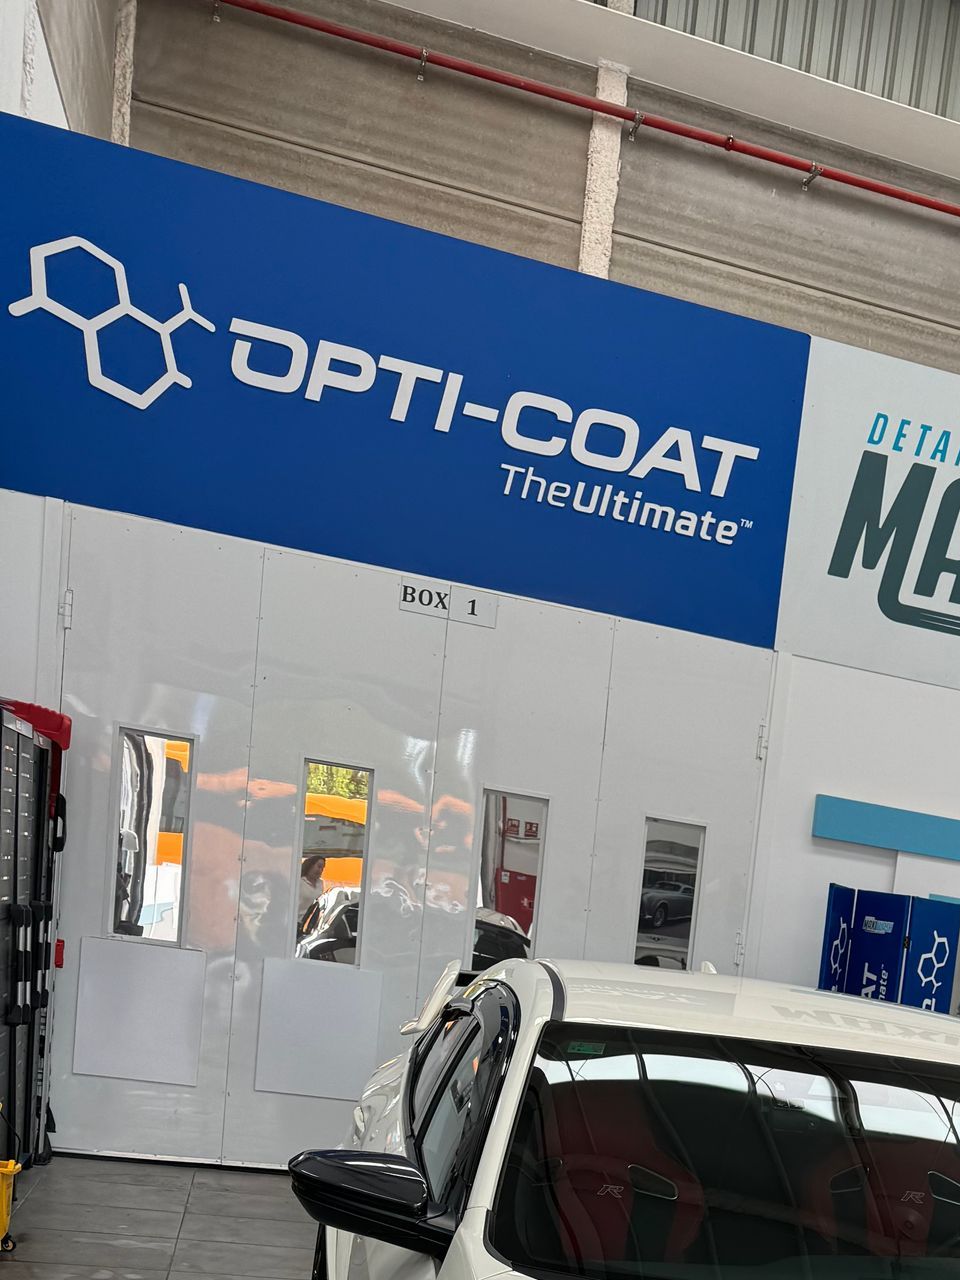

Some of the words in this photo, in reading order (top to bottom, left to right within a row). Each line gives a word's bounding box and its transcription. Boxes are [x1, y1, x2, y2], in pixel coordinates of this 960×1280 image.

[229, 317, 760, 497] OPTI-COAT
[402, 585, 449, 610] BOX
[467, 599, 478, 616] 1
